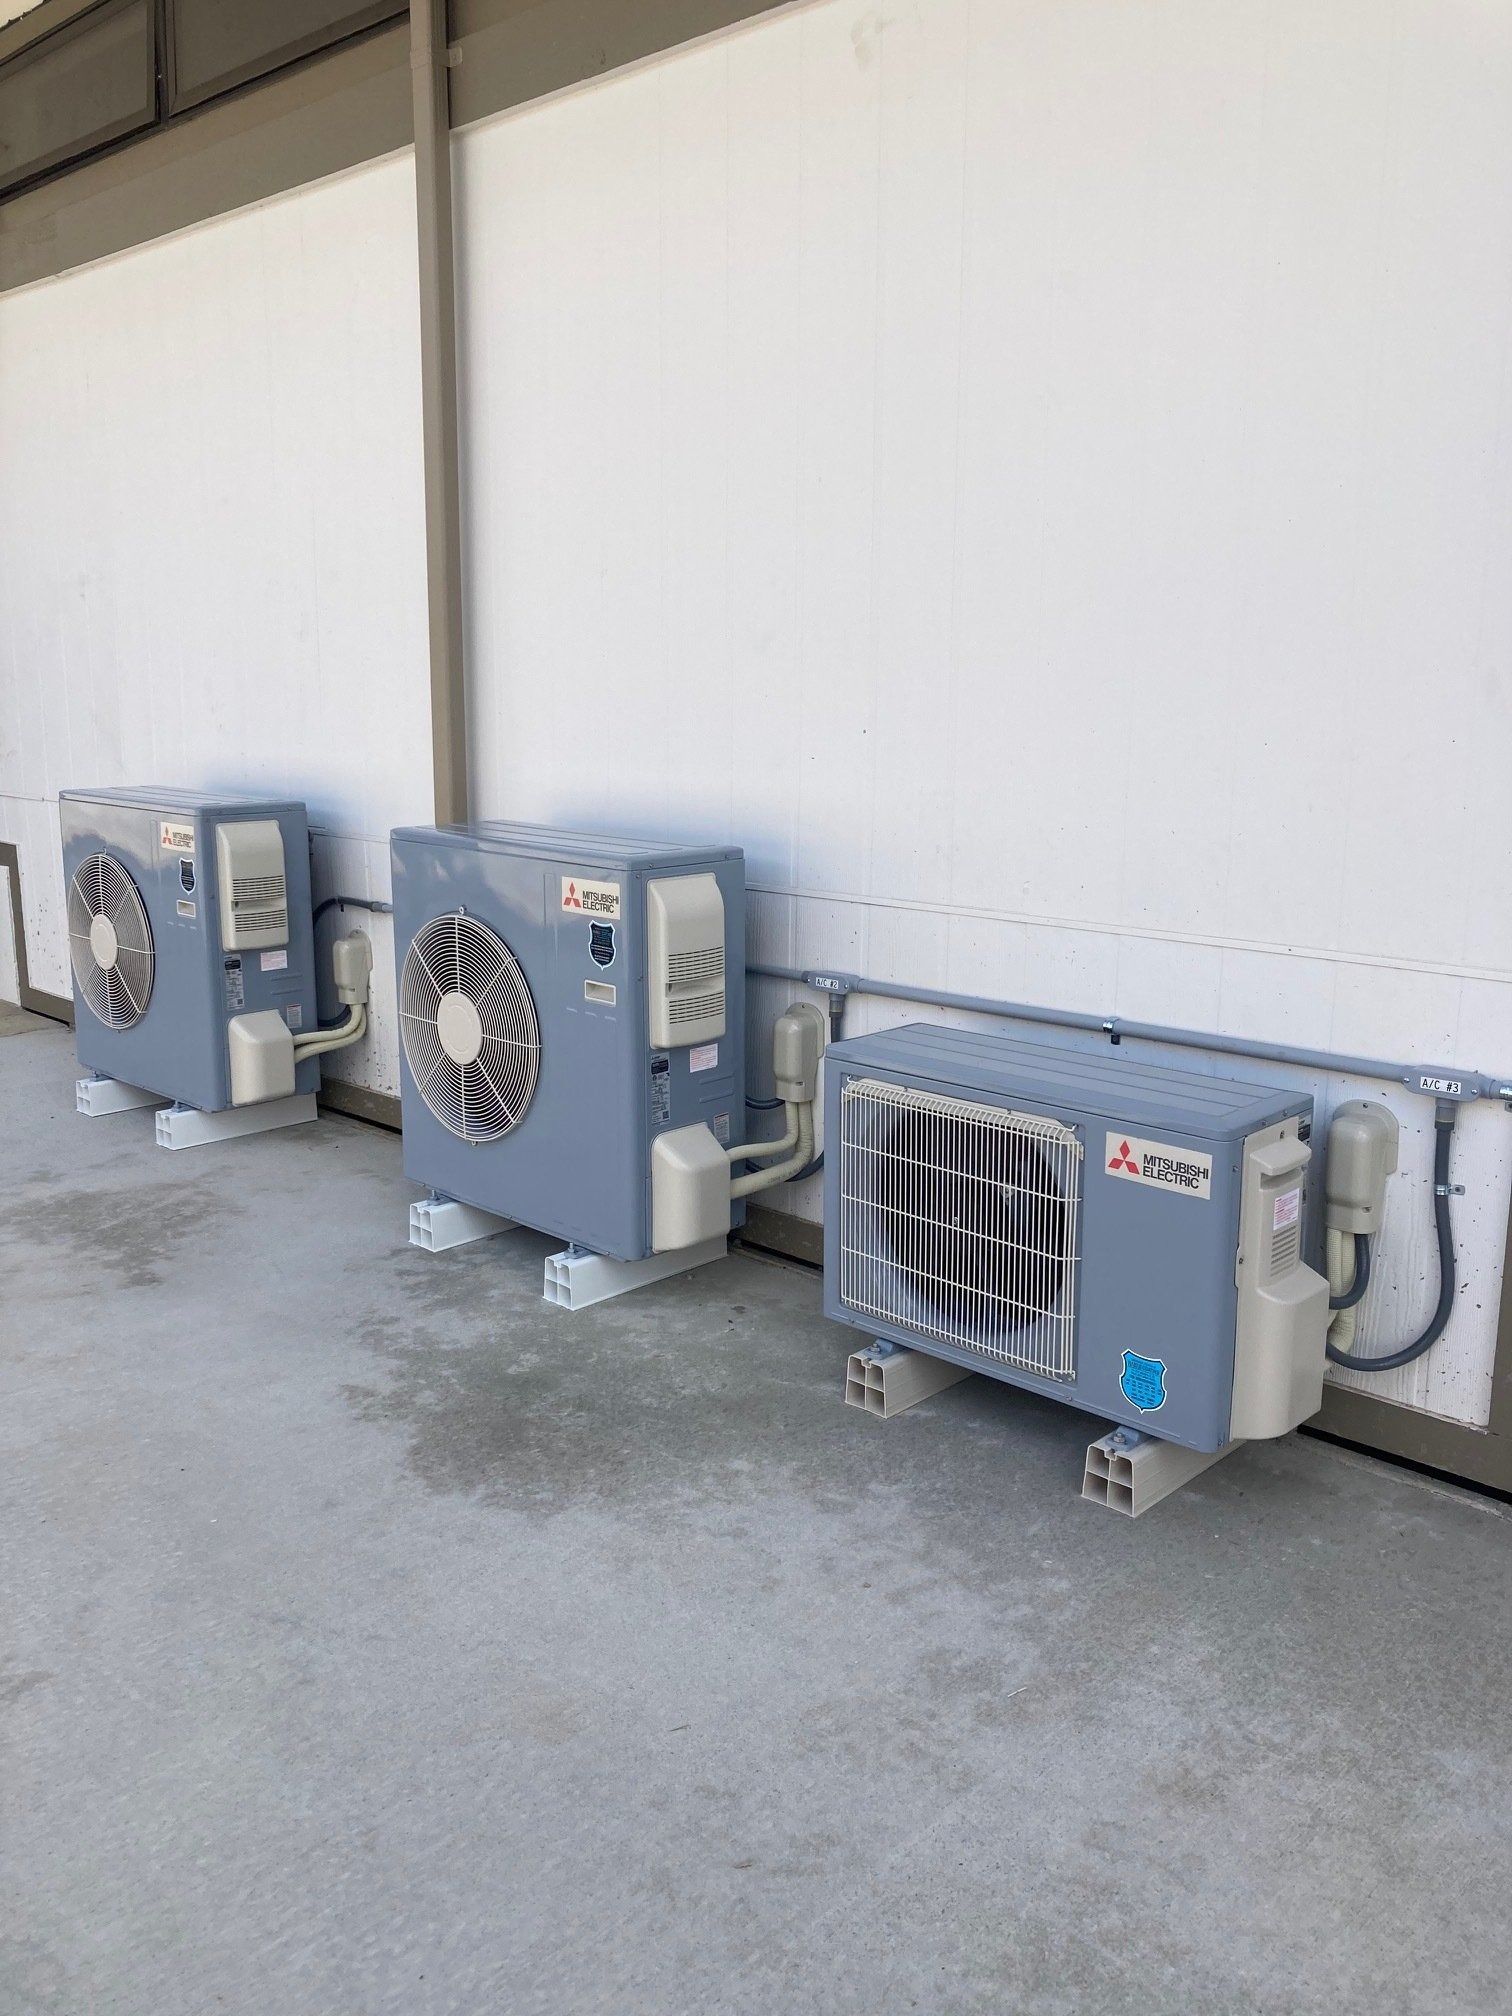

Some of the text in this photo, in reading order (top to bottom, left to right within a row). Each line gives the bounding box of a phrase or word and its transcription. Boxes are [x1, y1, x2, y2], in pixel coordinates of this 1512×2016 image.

[582, 890, 619, 905] MITSUBISHI
[582, 901, 615, 913] ELECTRIC
[816, 978, 838, 989] A/C #2
[1422, 1078, 1460, 1093] A/C #3
[1143, 1153, 1209, 1180] MITSUBISHI
[1142, 1165, 1200, 1189] ELECTRIC
